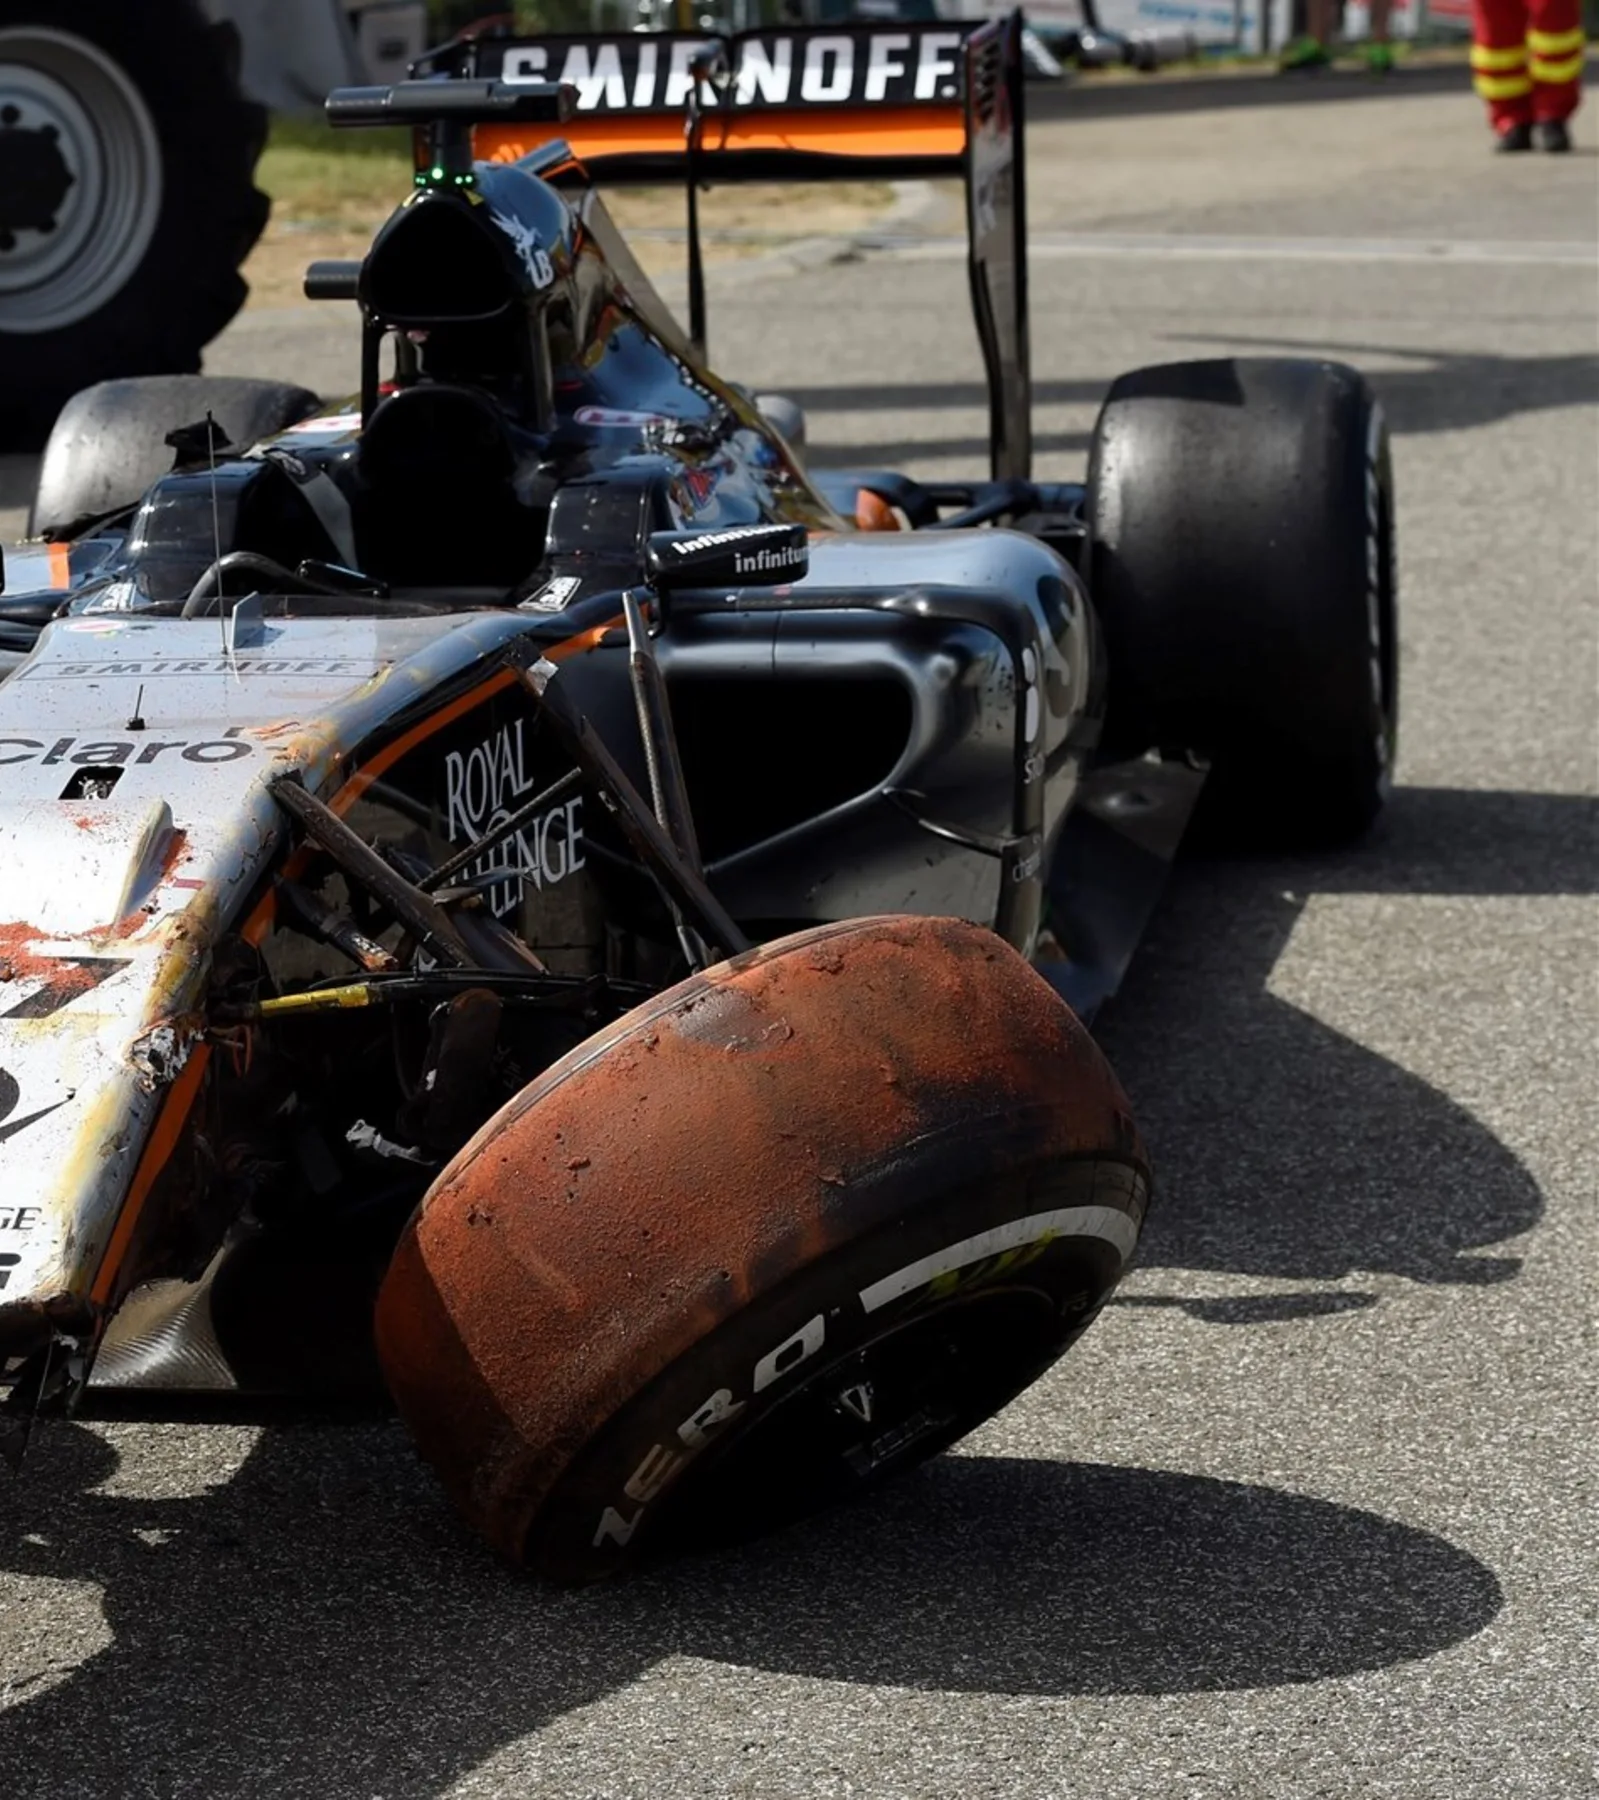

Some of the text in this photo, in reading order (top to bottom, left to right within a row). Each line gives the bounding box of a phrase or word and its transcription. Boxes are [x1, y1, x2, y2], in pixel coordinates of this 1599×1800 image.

[57, 660, 357, 675] SMIRNOFF
[445, 717, 534, 844] ROYAL
[450, 796, 587, 919] LENGE
[592, 1313, 827, 1548] ZERO
